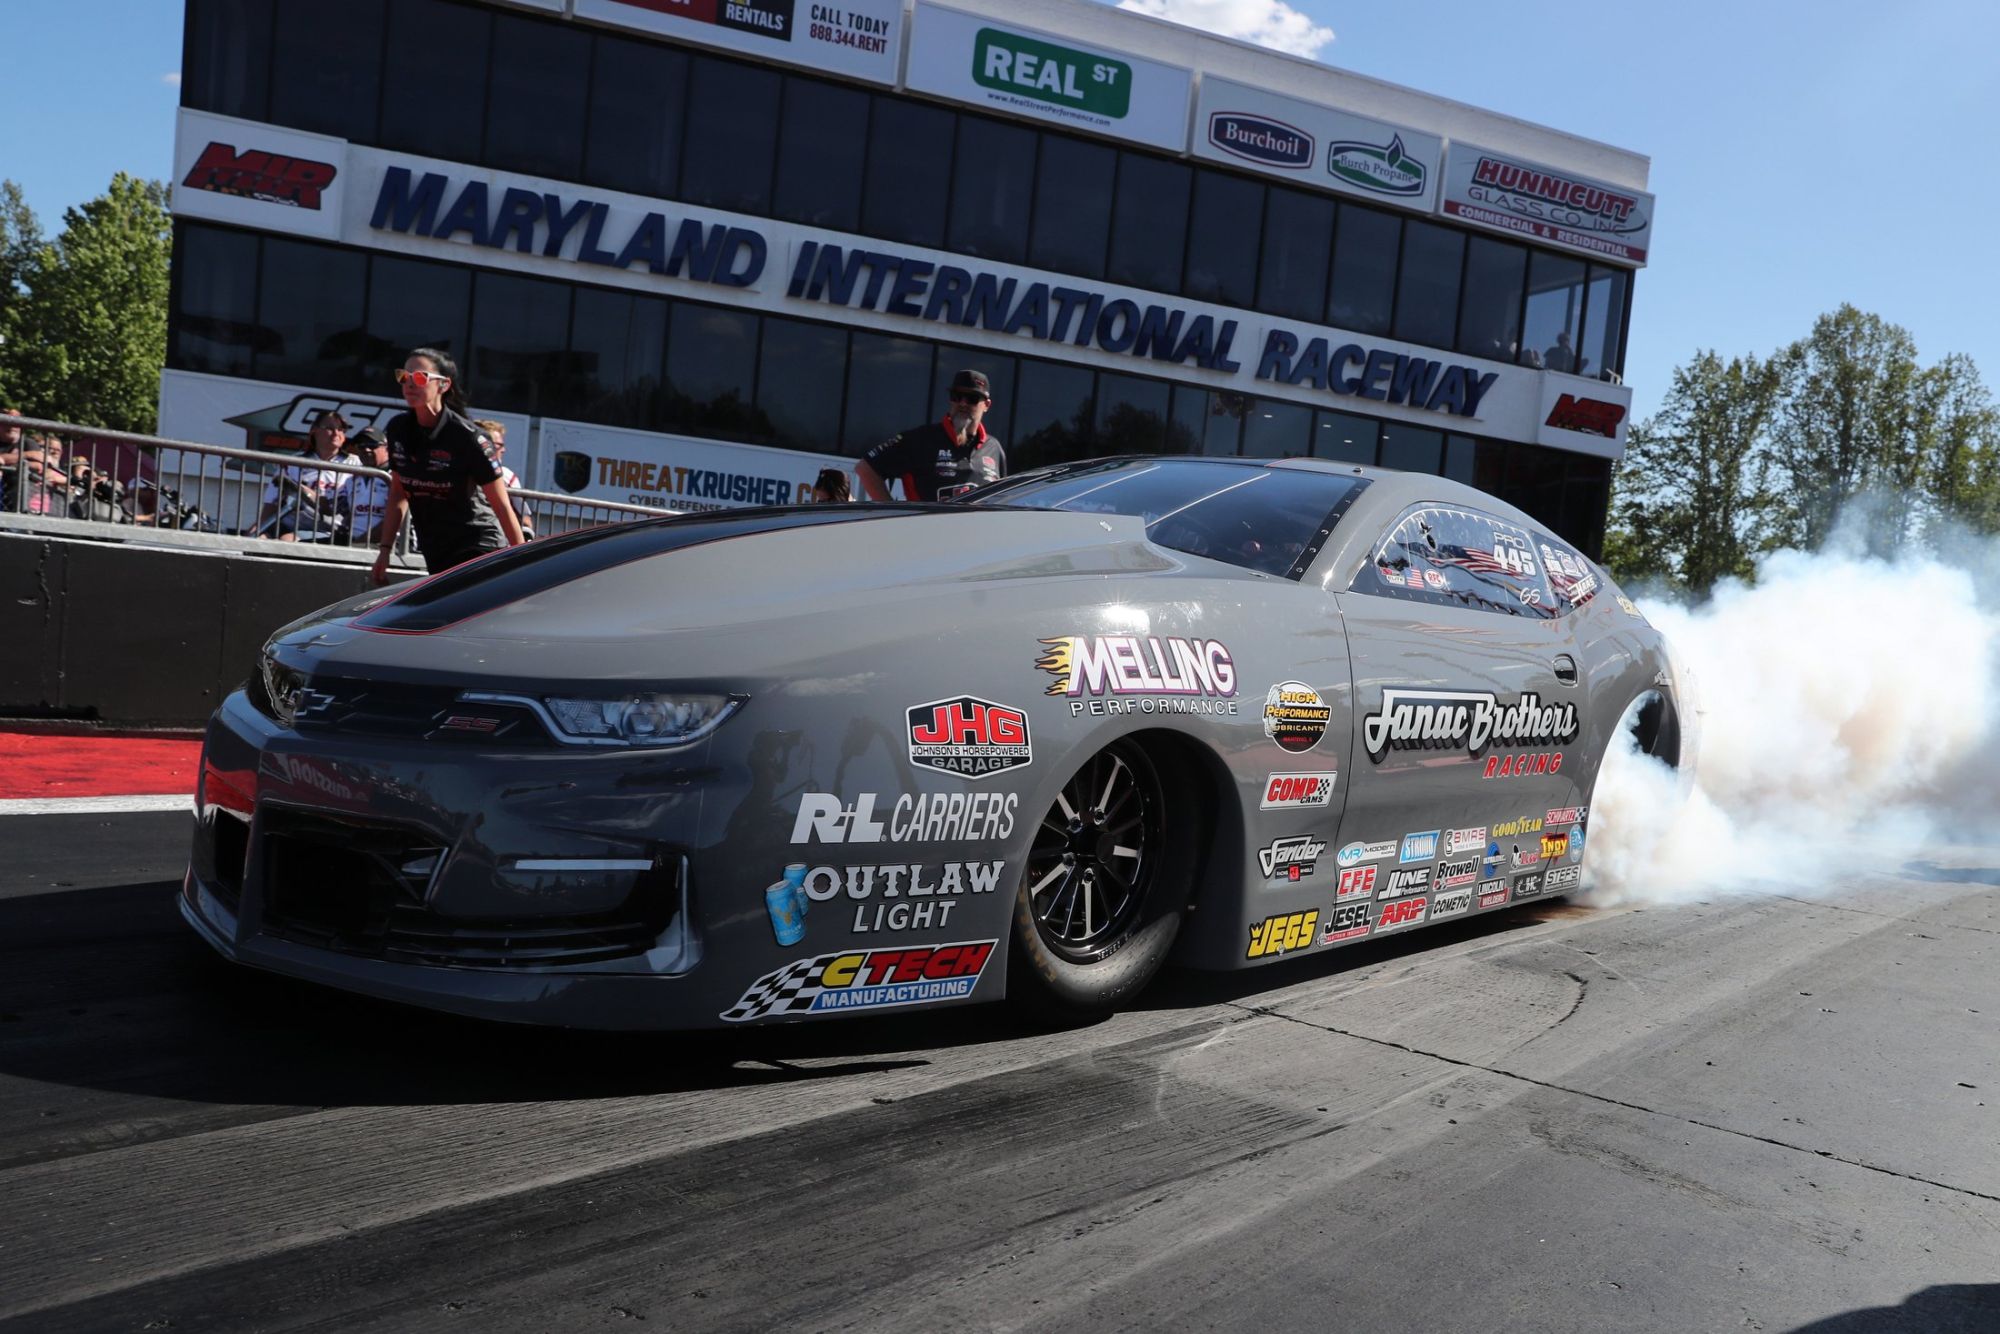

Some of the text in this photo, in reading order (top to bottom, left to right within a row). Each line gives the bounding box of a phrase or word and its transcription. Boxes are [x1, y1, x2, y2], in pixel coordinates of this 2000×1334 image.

[726, 4, 783, 30] RENTALS
[810, 4, 889, 36] CALL TODAY
[810, 23, 887, 54] 888.344.RENT
[984, 44, 1118, 99] REAL ST
[1226, 121, 1300, 156] Burchoil
[1339, 154, 1414, 183] Burch Propane
[1468, 187, 1543, 216] GLASS
[1473, 157, 1638, 222] HUNNICUTT
[1458, 205, 1628, 257] COMMERCIAL & RESIDENTIAL
[370, 166, 1499, 418] MARYLAND INTERNATIONAL RACEWAY
[629, 494, 666, 508] CYBER
[1493, 532, 1525, 549] PRO
[1493, 544, 1536, 576] 445
[1066, 636, 1238, 698] MELLING
[1069, 698, 1238, 717] PERFORMANCE
[1266, 705, 1329, 719] PERFORMANCE
[1280, 691, 1317, 704] HIGH
[912, 702, 1026, 745] JHG
[1365, 688, 1577, 755] Janac Brothers
[912, 746, 1029, 755] JOHNSON'S HORSEPOWERED
[931, 757, 1013, 773] GARAGE
[1483, 752, 1563, 779] RACING
[1267, 778, 1319, 802] COMP
[1300, 795, 1324, 804] CAMS
[890, 792, 1018, 842] CARRIERS
[1405, 835, 1435, 859] STROUD
[803, 860, 1005, 901] OUTLAW
[1338, 868, 1376, 896] CFE
[1437, 856, 1480, 879] Browell
[1478, 879, 1505, 896] LINCOLN
[852, 900, 956, 933] LIGHT
[1378, 897, 1427, 927] ARP
[1433, 894, 1470, 914] COMETIC
[1247, 909, 1319, 958] JEGS
[1324, 904, 1371, 934] JESEL
[821, 981, 968, 1008] MANUFACTURING
